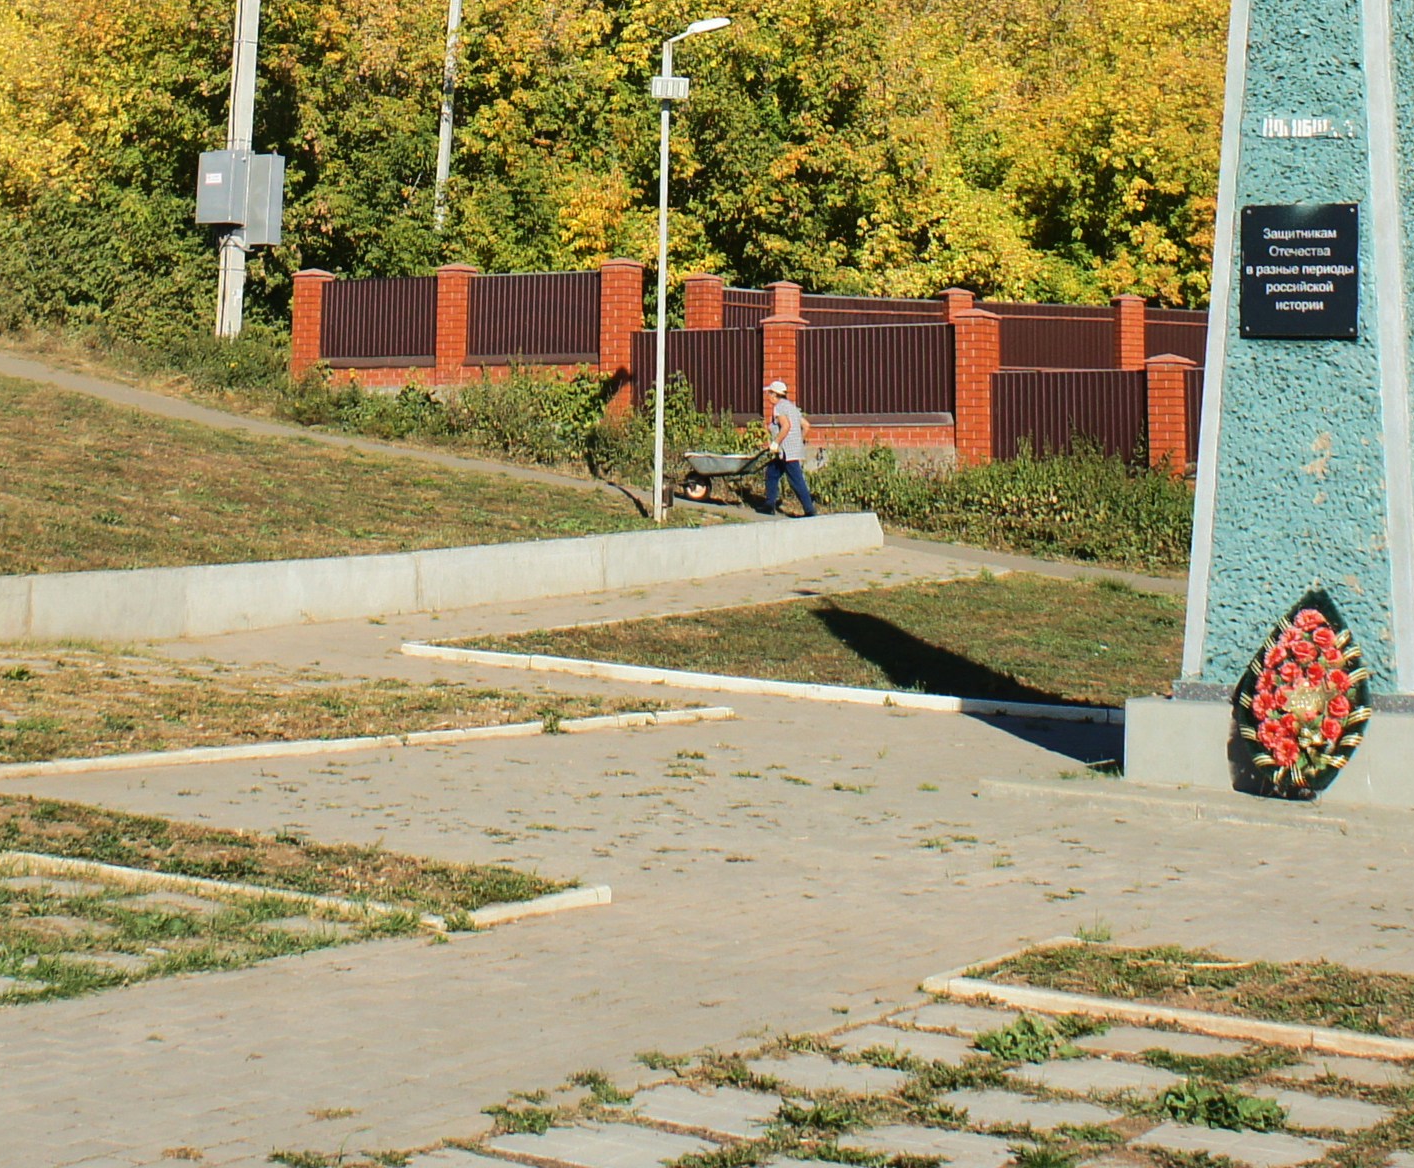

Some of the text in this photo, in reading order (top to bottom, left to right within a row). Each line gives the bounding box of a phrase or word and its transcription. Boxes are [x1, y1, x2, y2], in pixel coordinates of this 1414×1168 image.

[1263, 228, 1336, 240] Защитникам
[1269, 246, 1331, 256] Отечества
[1246, 265, 1354, 277] в разные периоды
[1266, 281, 1334, 295] российской
[1276, 301, 1324, 312] истории
